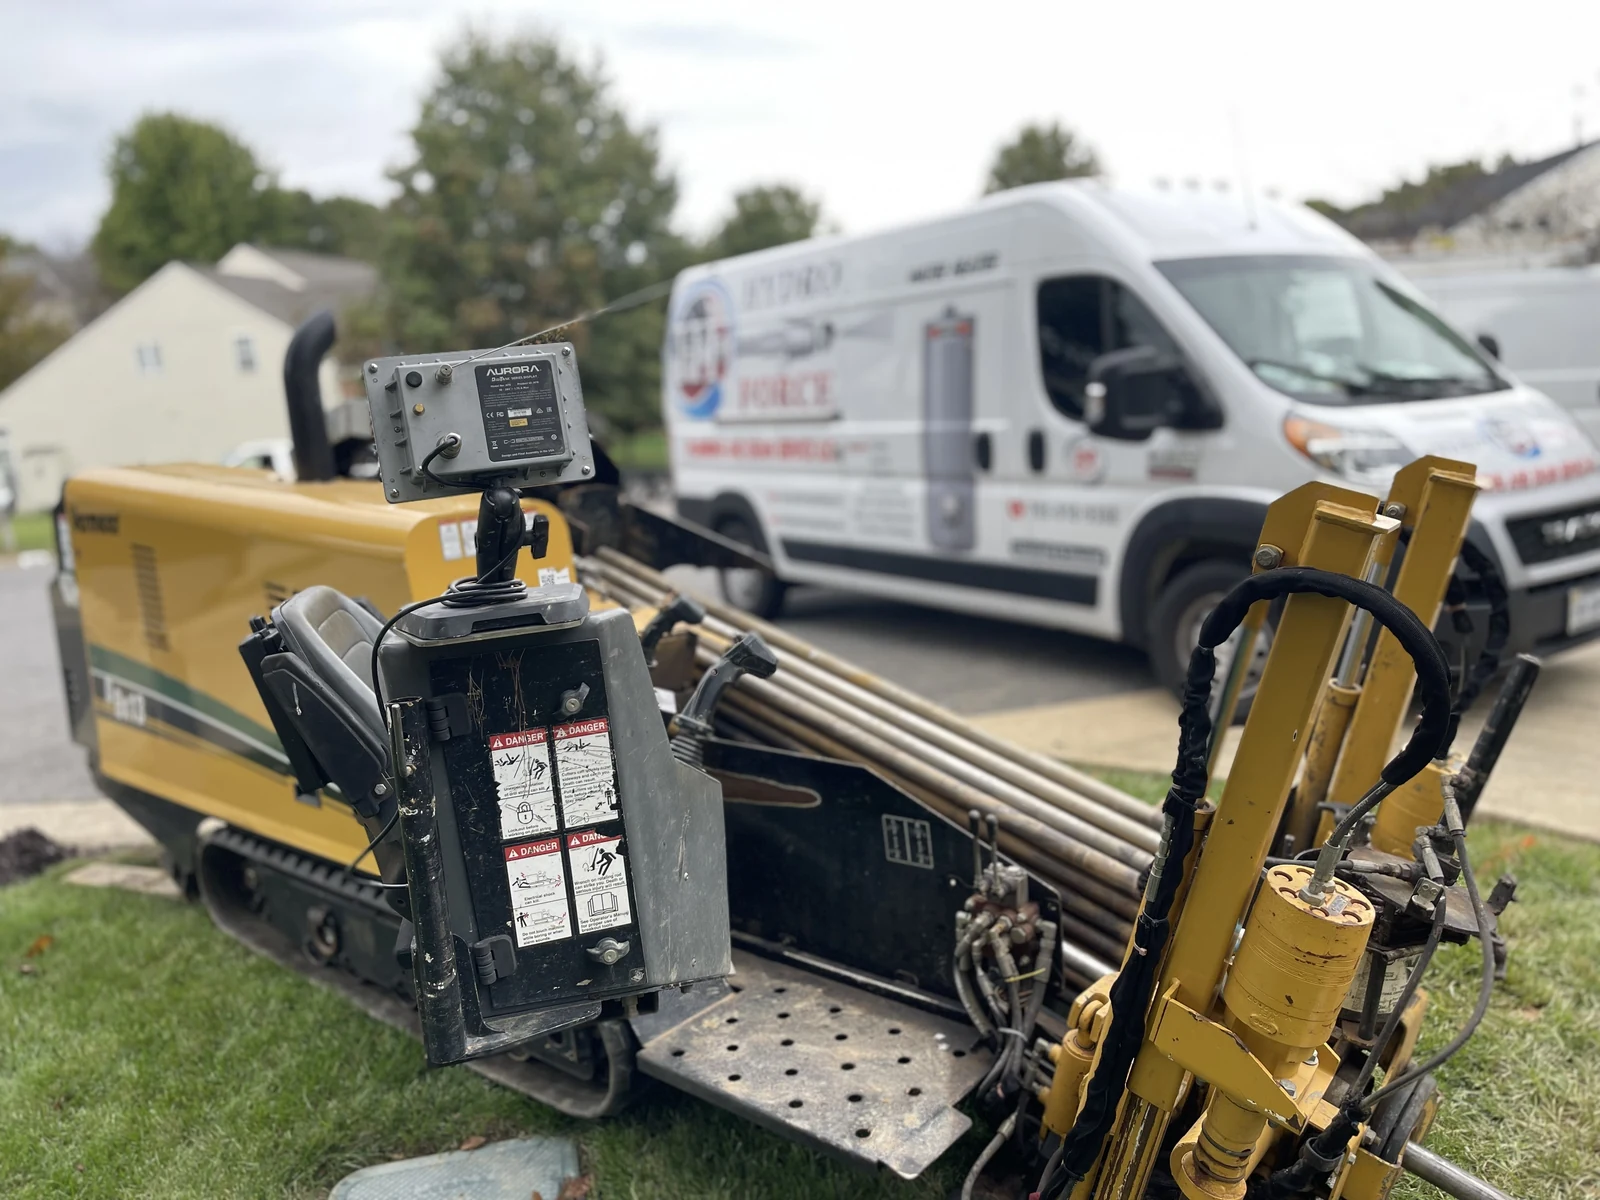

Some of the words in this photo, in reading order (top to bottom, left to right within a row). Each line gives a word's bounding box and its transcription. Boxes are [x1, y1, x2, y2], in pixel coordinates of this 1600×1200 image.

[486, 365, 540, 376] AURORA
[569, 722, 605, 735] DANGER
[505, 732, 544, 746] DANGER
[582, 831, 607, 842] DAN
[520, 842, 558, 856] DANGER
[582, 925, 601, 933] breakout
